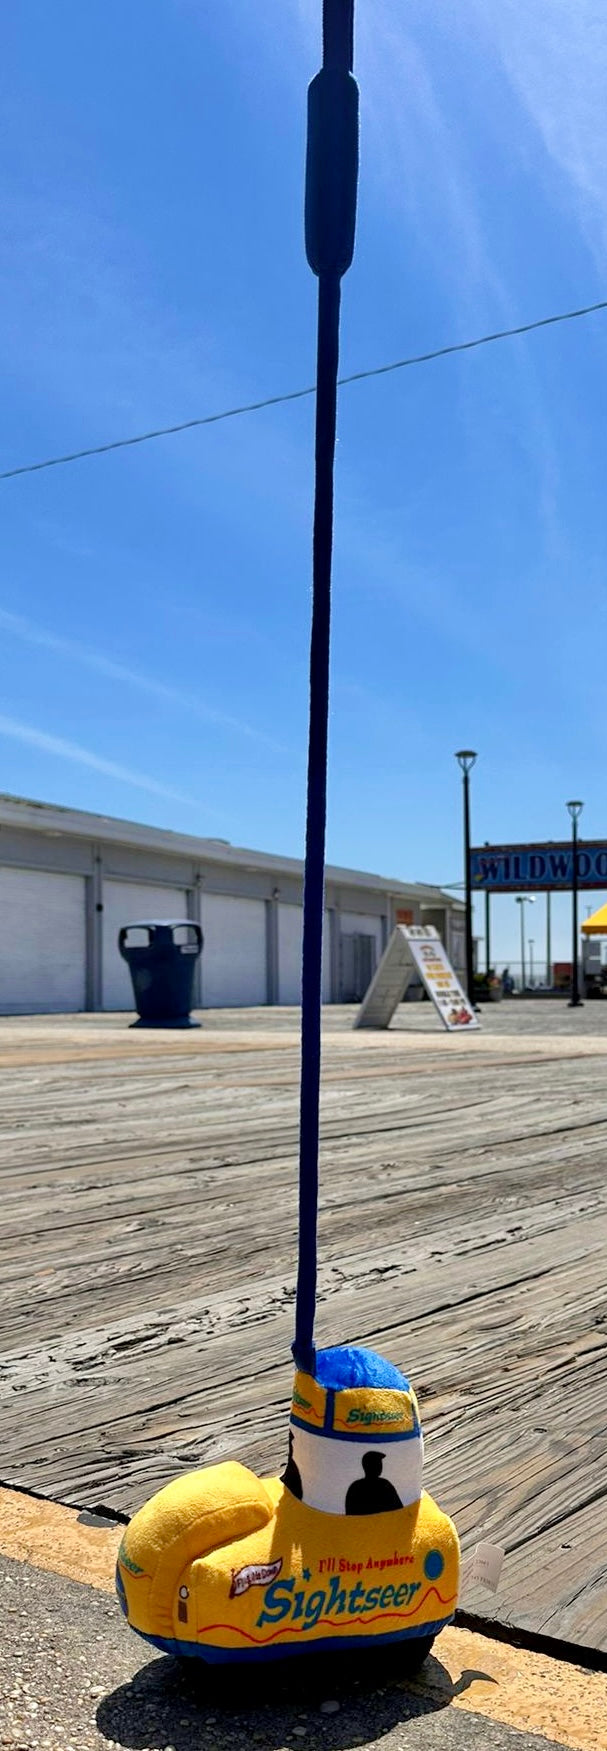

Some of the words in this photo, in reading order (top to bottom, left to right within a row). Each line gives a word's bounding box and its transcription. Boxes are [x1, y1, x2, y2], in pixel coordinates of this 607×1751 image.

[319, 1557, 335, 1573] I'll
[339, 1558, 363, 1574] Stop
[366, 1551, 414, 1571] Anywhere
[256, 1576, 422, 1630] Sightseer
